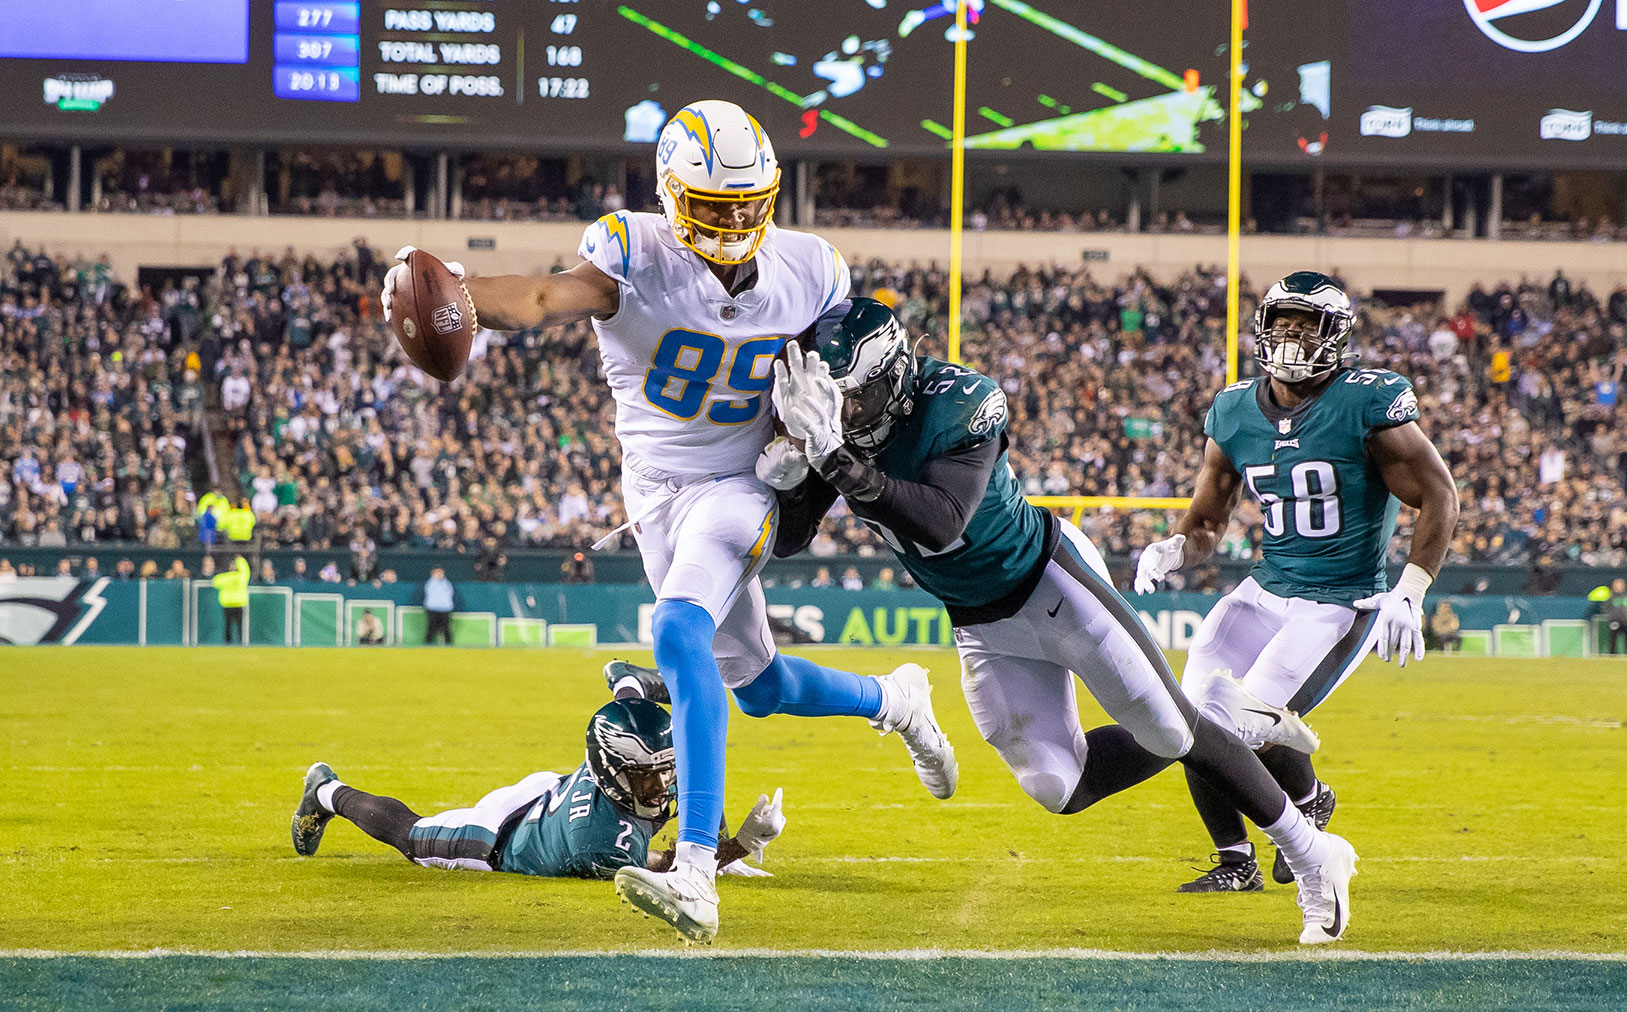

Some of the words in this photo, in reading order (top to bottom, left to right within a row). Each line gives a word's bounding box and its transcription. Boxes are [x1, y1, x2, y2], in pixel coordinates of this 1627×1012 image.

[298, 9, 333, 27] 277
[385, 9, 433, 31] PASS
[433, 11, 496, 33] YARDS
[550, 13, 578, 35] 47
[298, 41, 333, 59] 307
[378, 41, 438, 63] TOTAL
[439, 43, 501, 65] YARDS
[373, 73, 419, 94] TIME
[419, 74, 448, 95] OF
[448, 75, 504, 97] POSS.
[538, 77, 590, 98] 17:22
[658, 135, 678, 165] 89
[435, 307, 453, 331] NFL
[642, 327, 789, 426] 89
[1245, 460, 1341, 538] 58
[614, 819, 633, 852] 2
